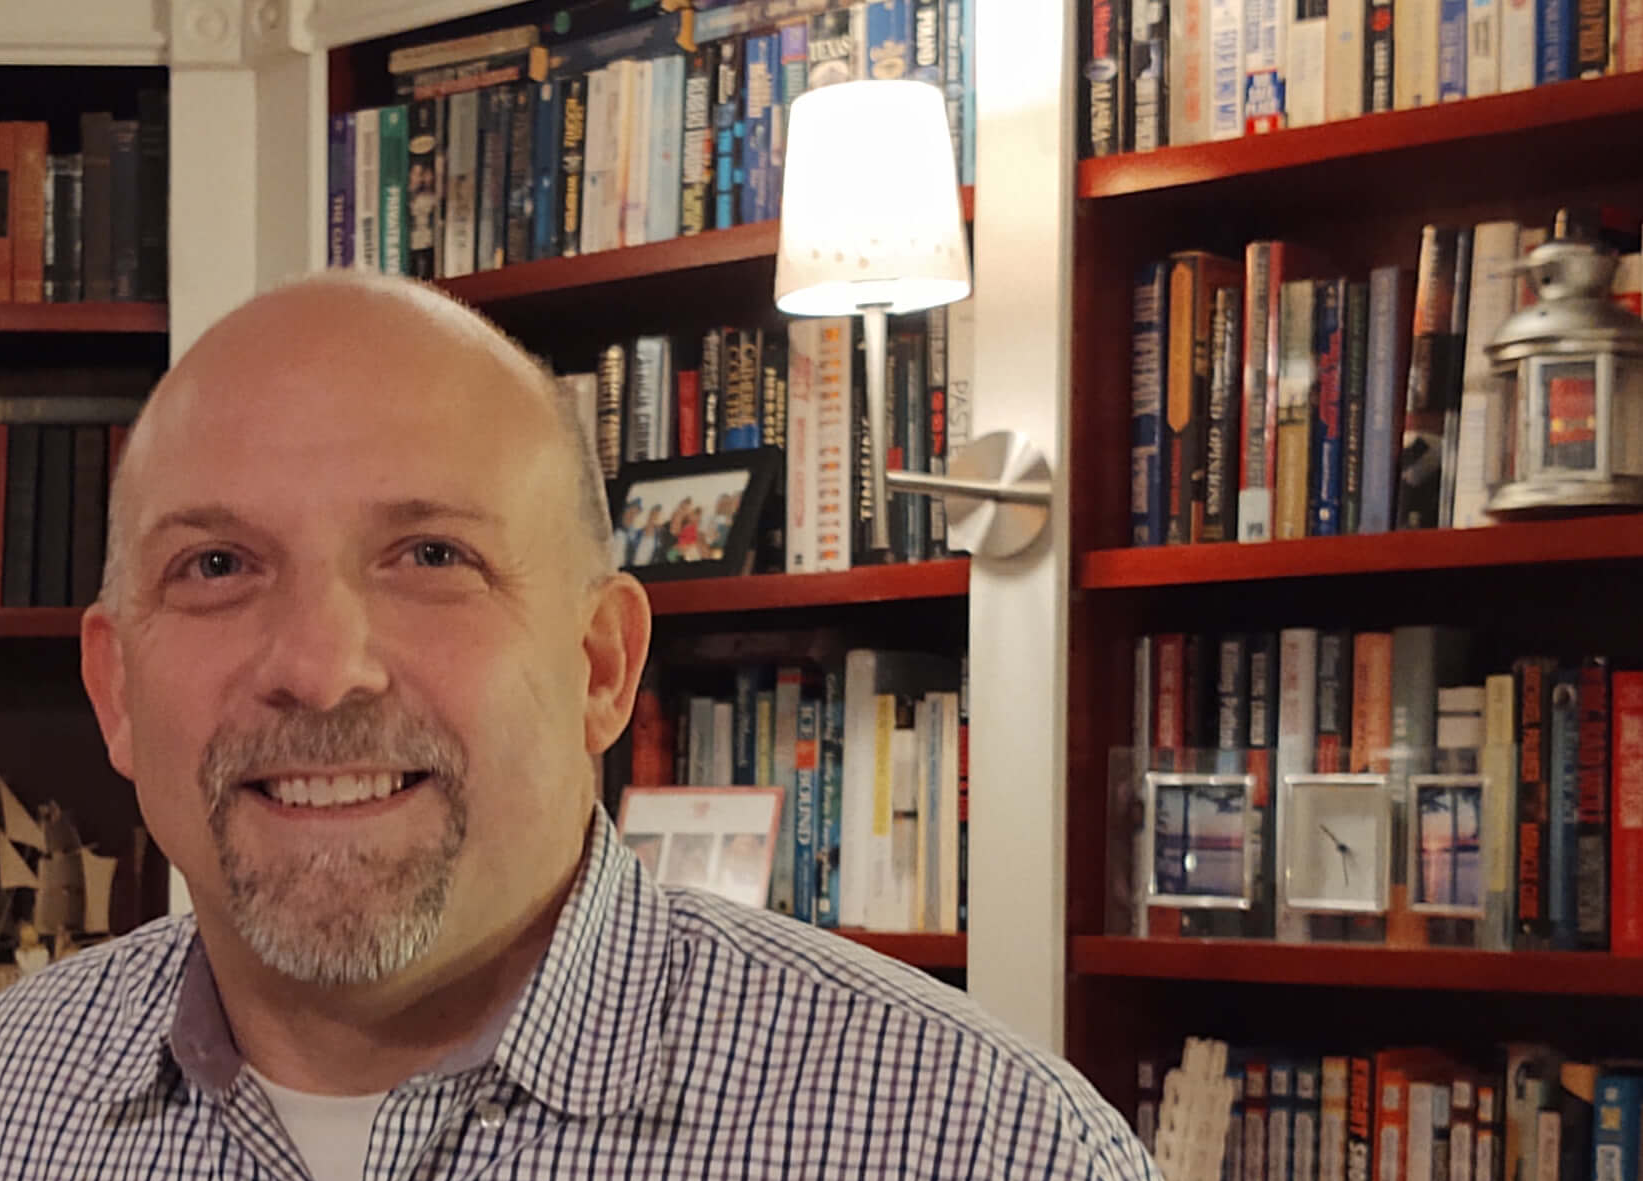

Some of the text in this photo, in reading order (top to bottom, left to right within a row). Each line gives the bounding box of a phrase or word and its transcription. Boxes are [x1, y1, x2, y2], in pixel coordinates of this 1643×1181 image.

[1091, 82, 1112, 142] ALASKA
[818, 327, 841, 563] MICHAEL CRICHTON
[1206, 427, 1222, 516] OPINIONS
[798, 705, 814, 845] ICE BOUND
[1351, 1058, 1370, 1138] KNIGHT
